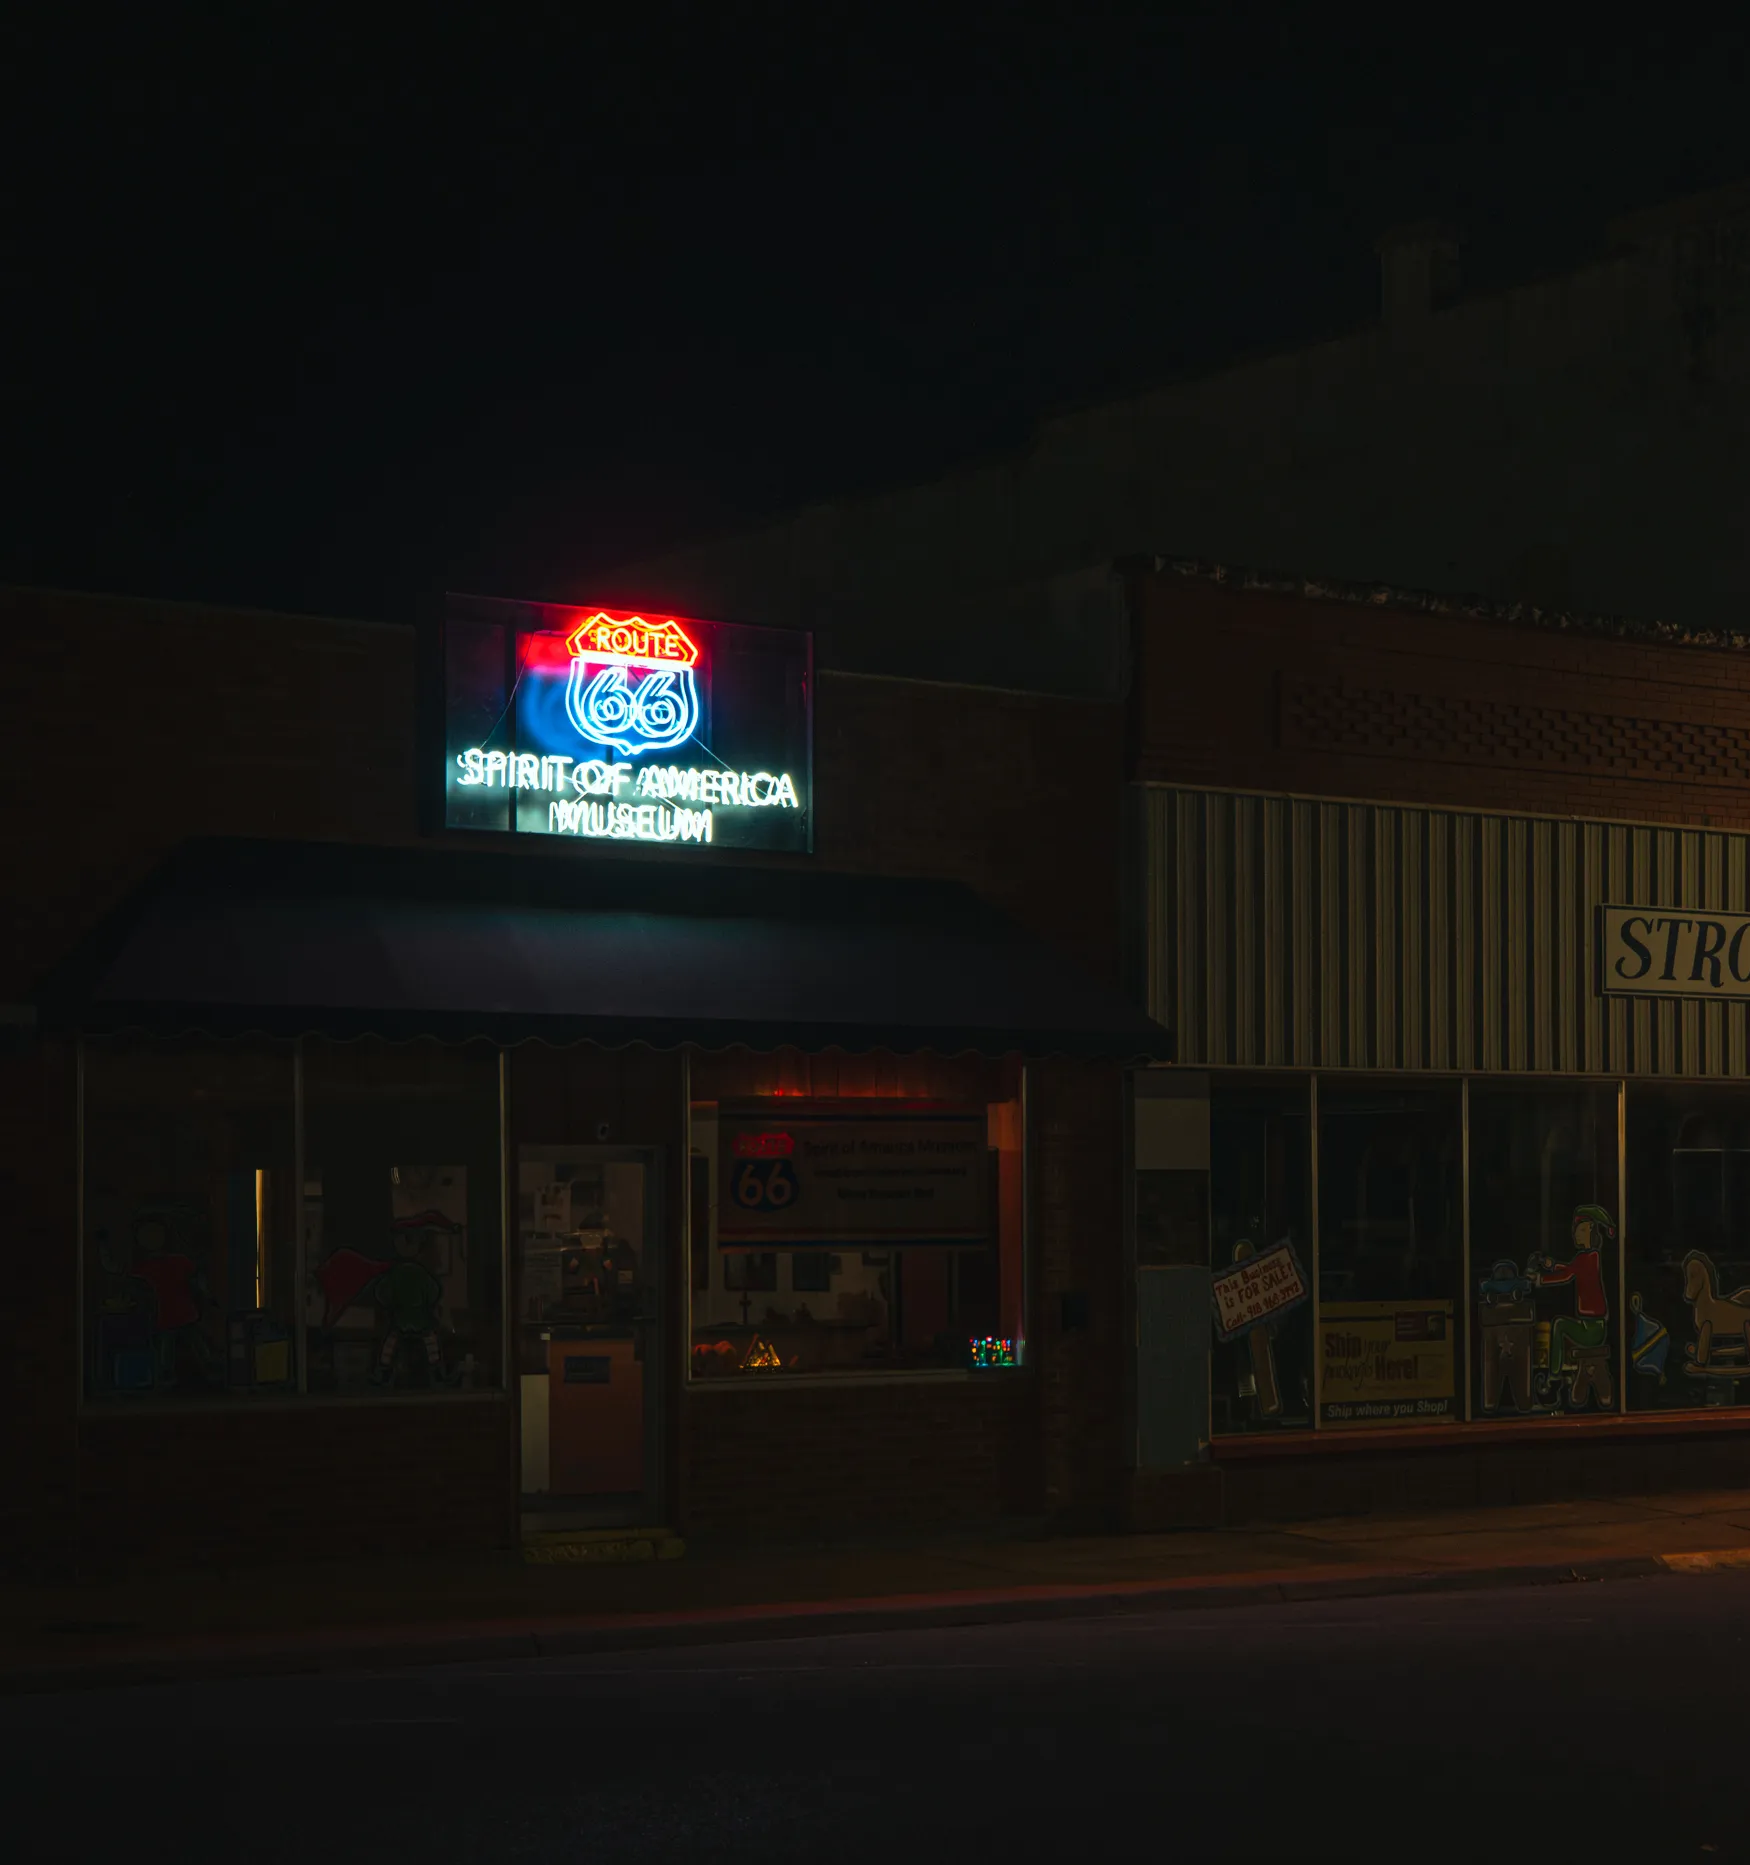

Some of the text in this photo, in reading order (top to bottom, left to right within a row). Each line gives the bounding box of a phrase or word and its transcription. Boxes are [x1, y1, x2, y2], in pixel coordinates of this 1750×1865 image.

[597, 626, 681, 657] ROUTE
[583, 667, 687, 738] 66
[457, 748, 799, 808] SPIRIT OF AMERICA
[549, 800, 713, 843] MUSEUM
[738, 1162, 792, 1206] 66
[1223, 1261, 1294, 1309] is FOR SALE!
[1325, 1332, 1362, 1359] Ship
[1327, 1399, 1448, 1419] Ship where you Shop!
